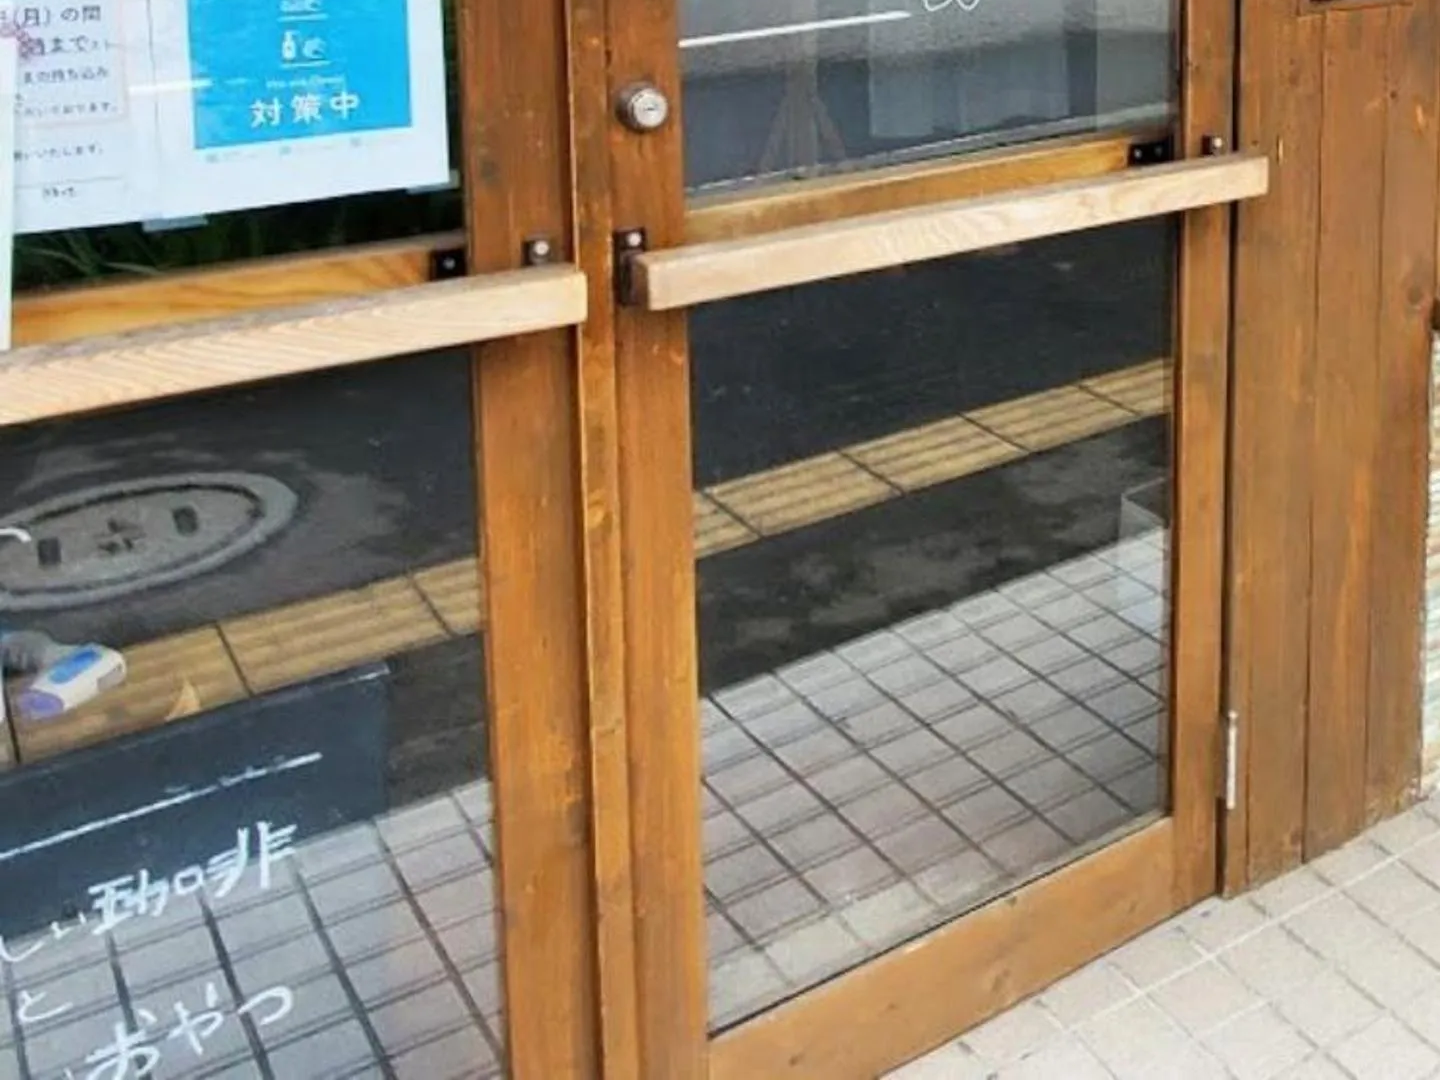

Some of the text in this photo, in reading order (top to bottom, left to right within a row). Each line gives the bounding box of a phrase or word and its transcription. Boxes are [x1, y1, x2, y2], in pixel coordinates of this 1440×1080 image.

[250, 90, 361, 128] 対策中
[85, 982, 294, 1080] おやつ
